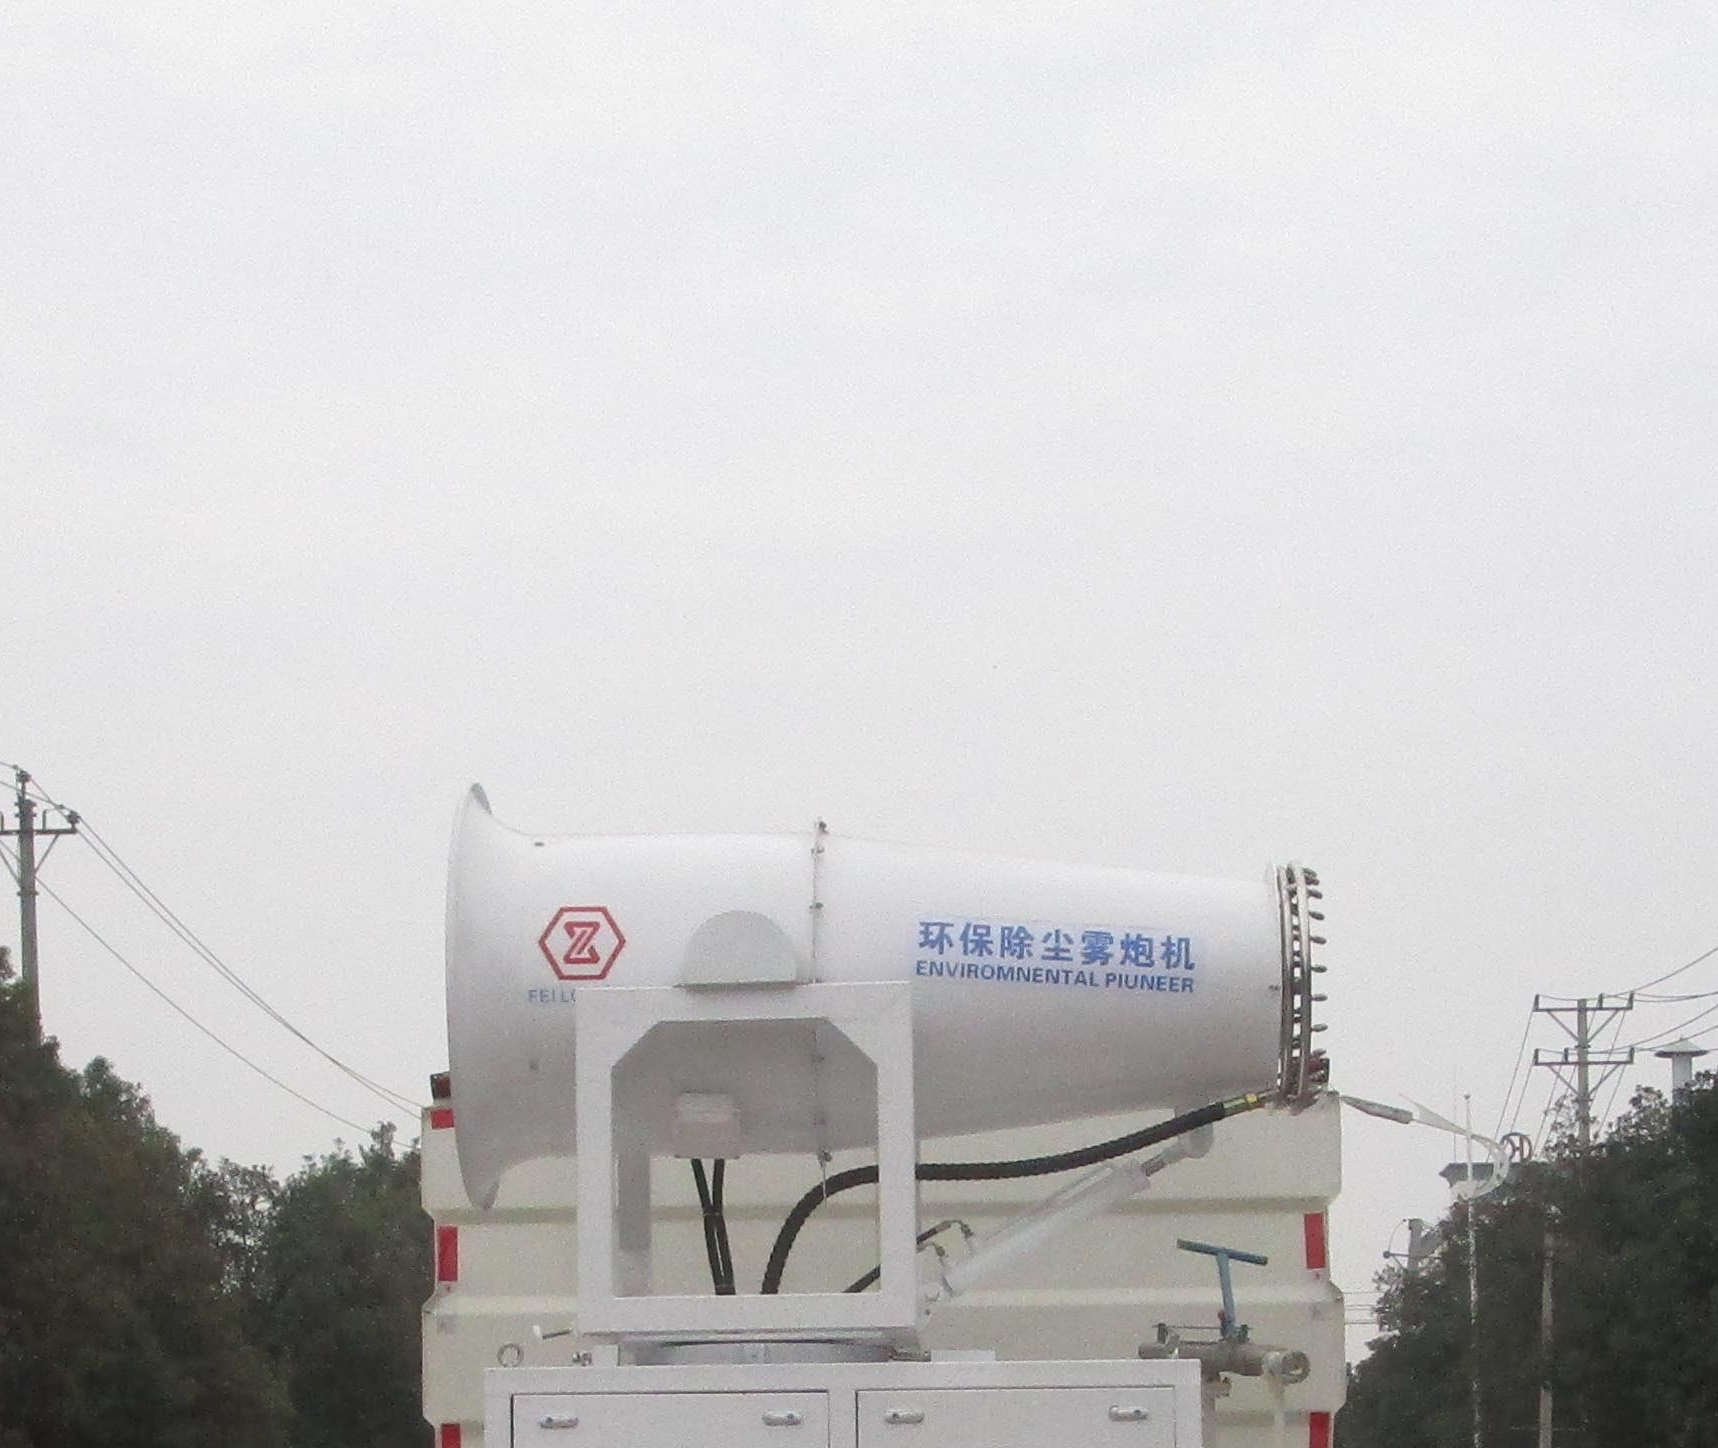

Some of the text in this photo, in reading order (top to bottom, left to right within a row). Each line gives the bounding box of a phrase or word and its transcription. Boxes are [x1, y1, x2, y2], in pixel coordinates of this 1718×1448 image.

[918, 920, 1195, 970] 环保除尘雾炮机
